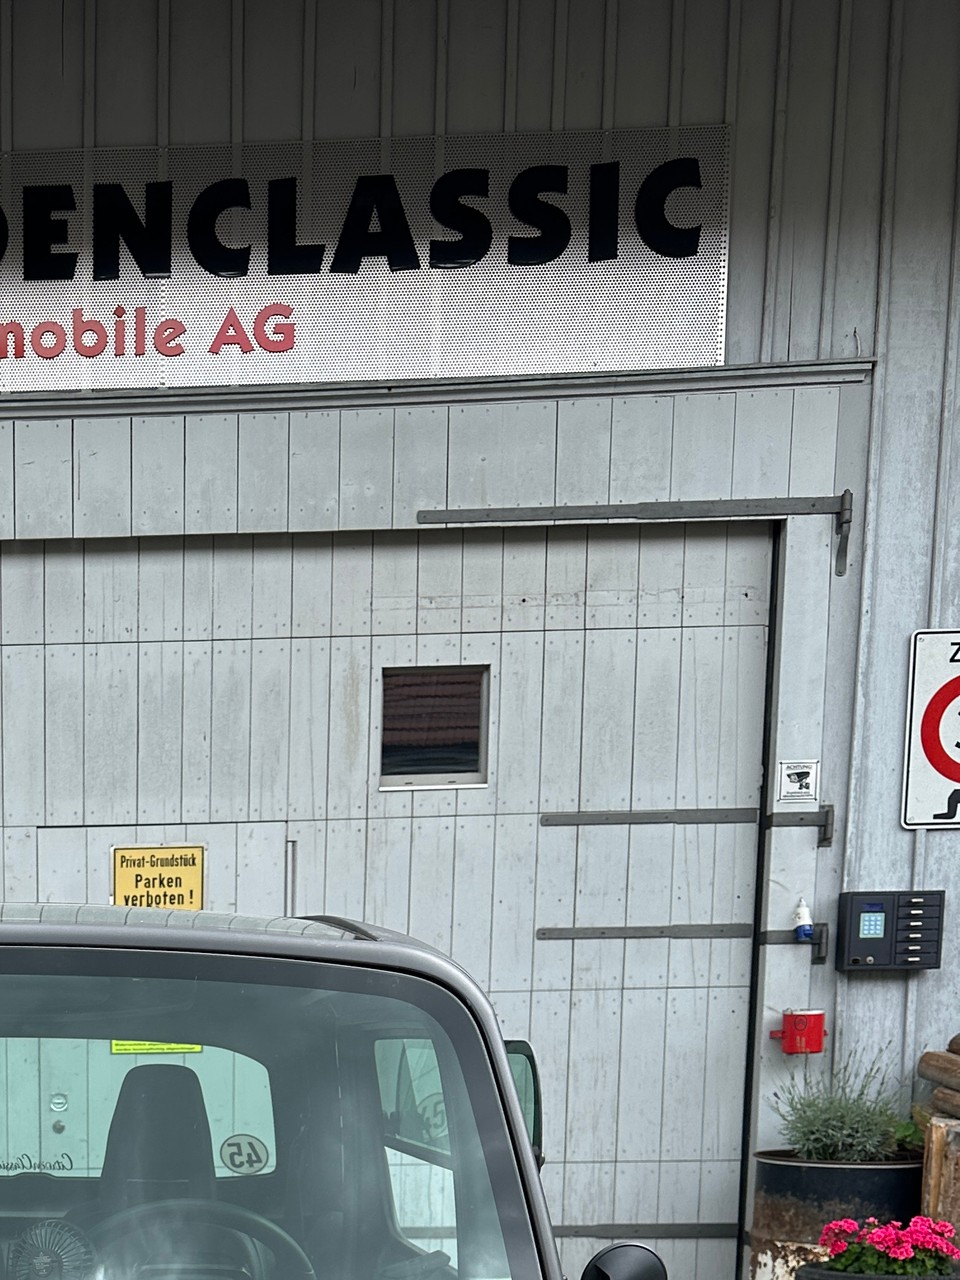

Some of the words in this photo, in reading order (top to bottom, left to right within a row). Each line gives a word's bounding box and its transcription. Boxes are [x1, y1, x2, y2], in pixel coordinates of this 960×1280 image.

[208, 303, 297, 356] AG
[120, 853, 197, 869] Privat-Grundstück
[135, 873, 182, 888] Parken
[124, 890, 184, 906] verboten
